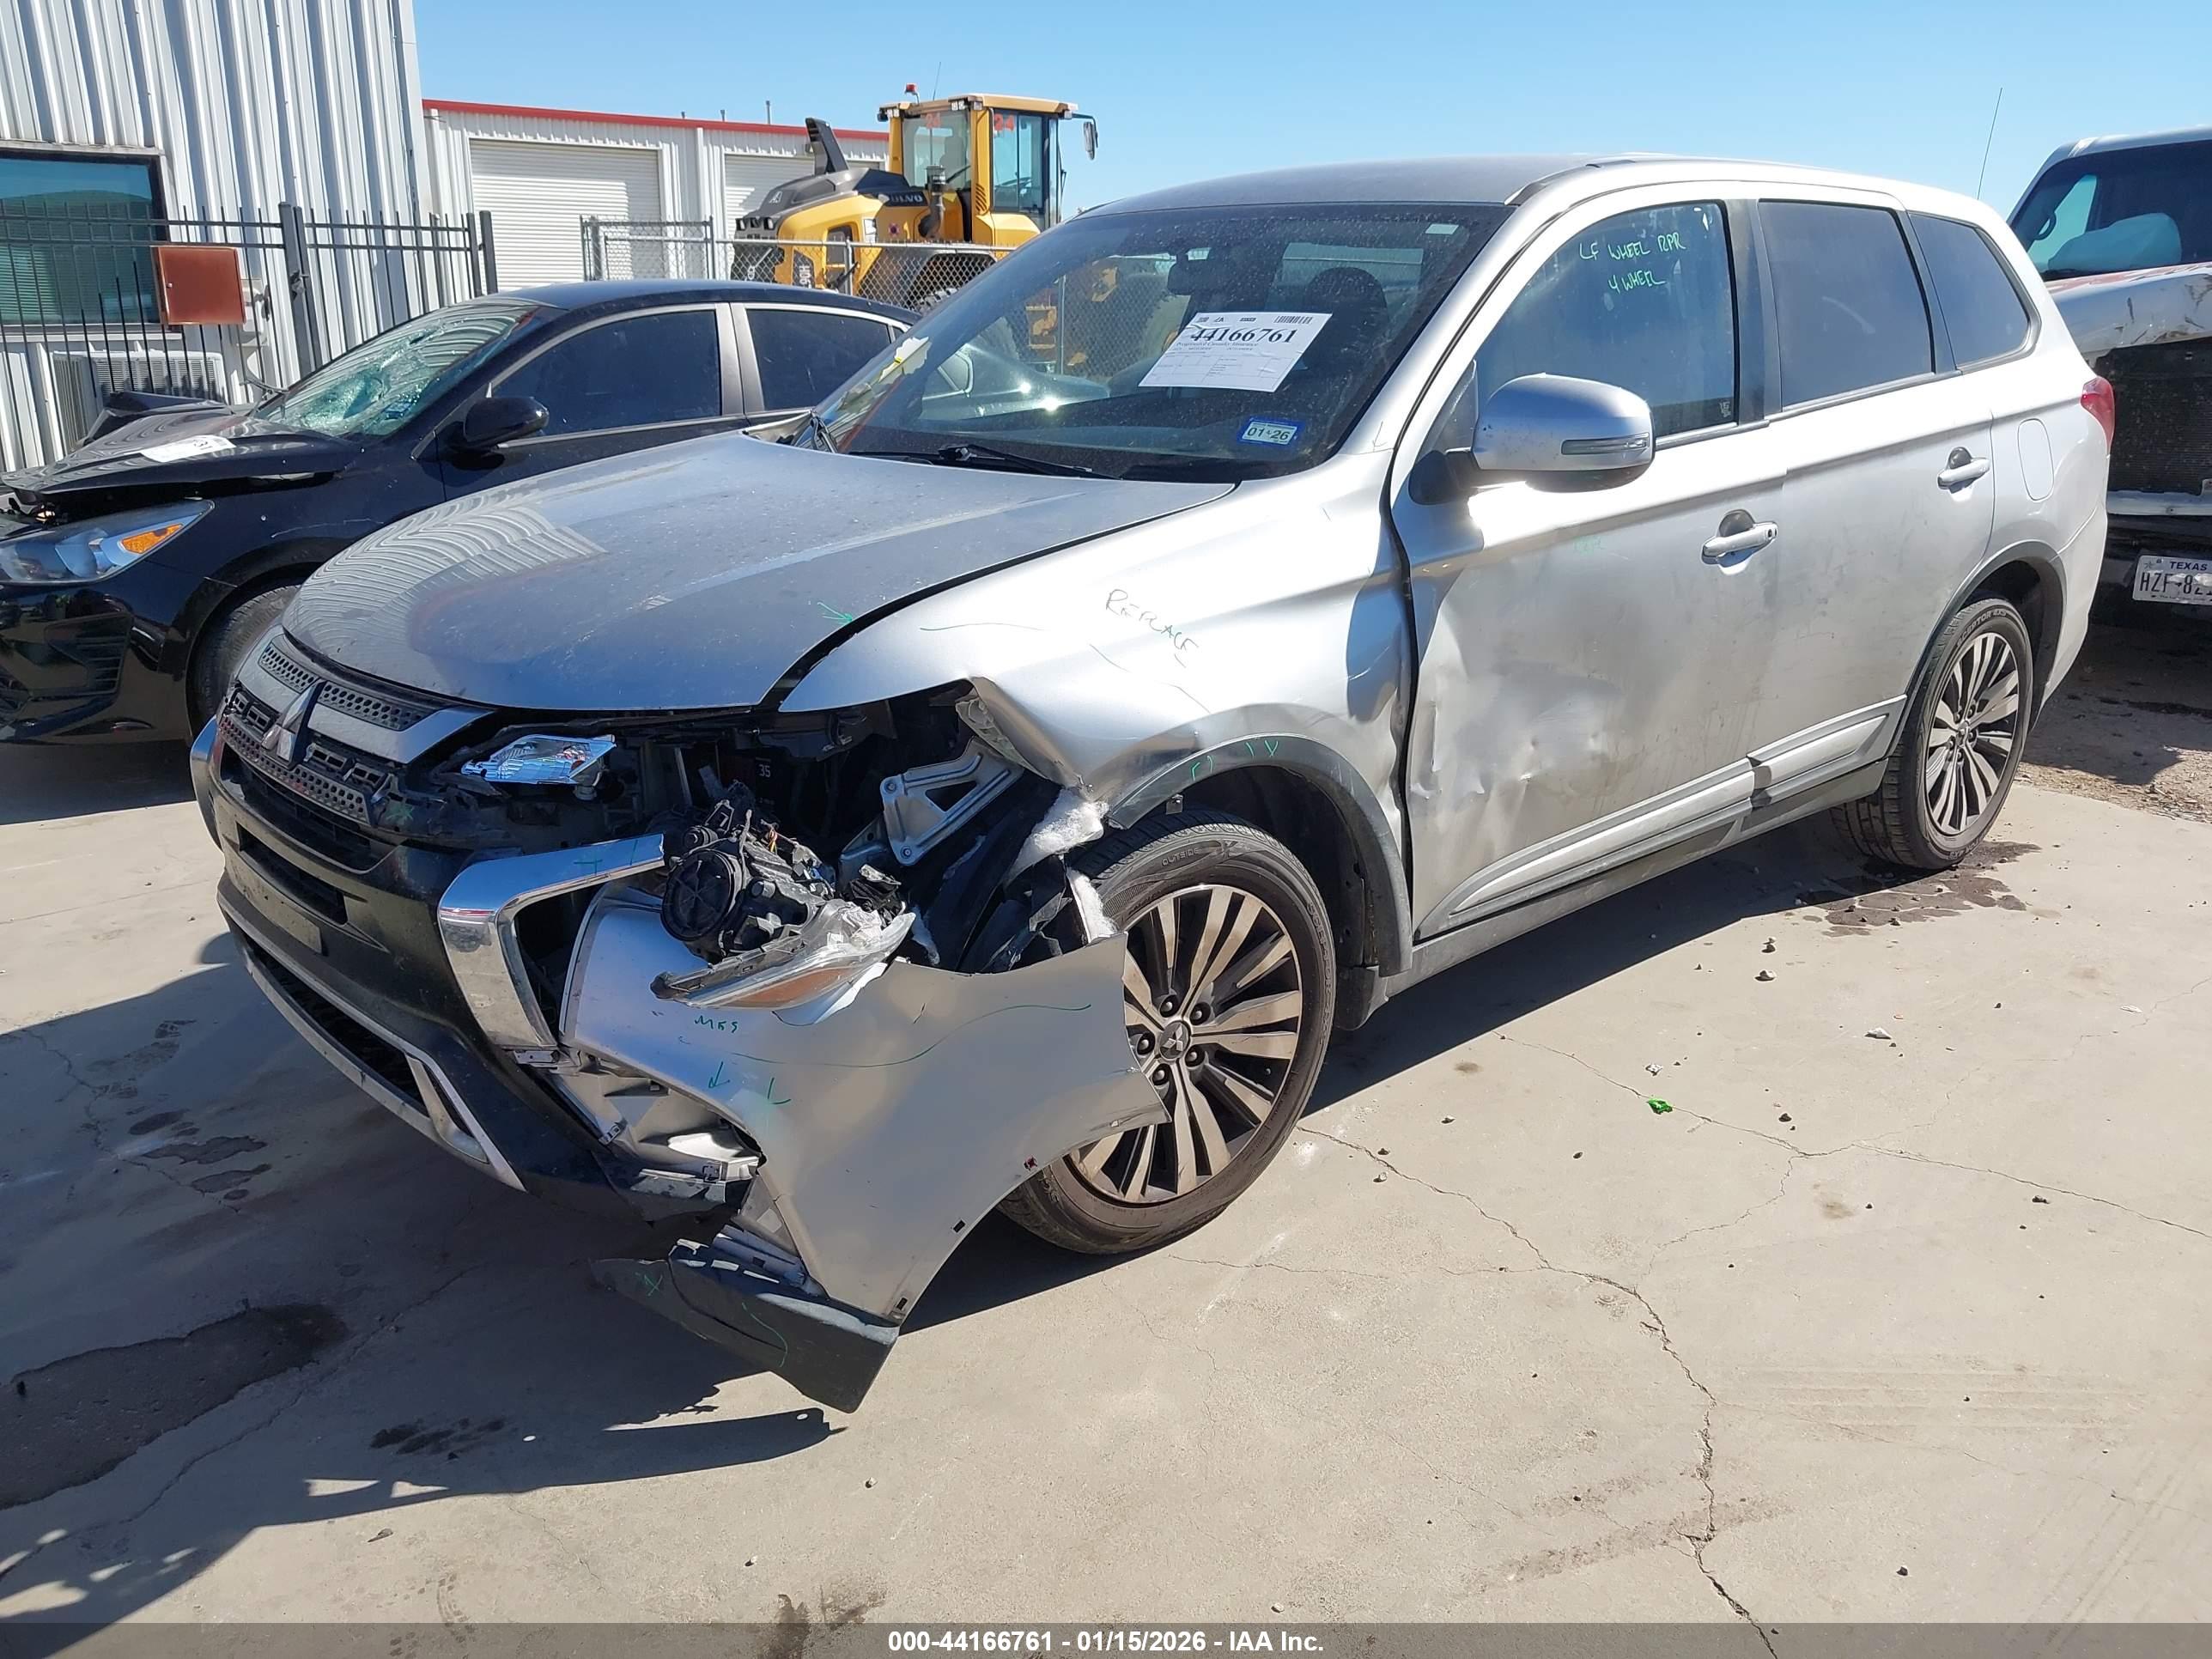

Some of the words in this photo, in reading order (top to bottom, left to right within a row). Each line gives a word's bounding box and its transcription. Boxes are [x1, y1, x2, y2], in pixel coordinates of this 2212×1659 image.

[1579, 241, 1600, 261] LF
[1607, 241, 1651, 260] WHEEL
[1608, 275, 1621, 295] 4
[1622, 270, 1666, 292] WHEEL
[1190, 328, 1298, 343] 44166761
[2169, 561, 2208, 572] TEXAS
[1161, 847, 1200, 866] OUTSIDE
